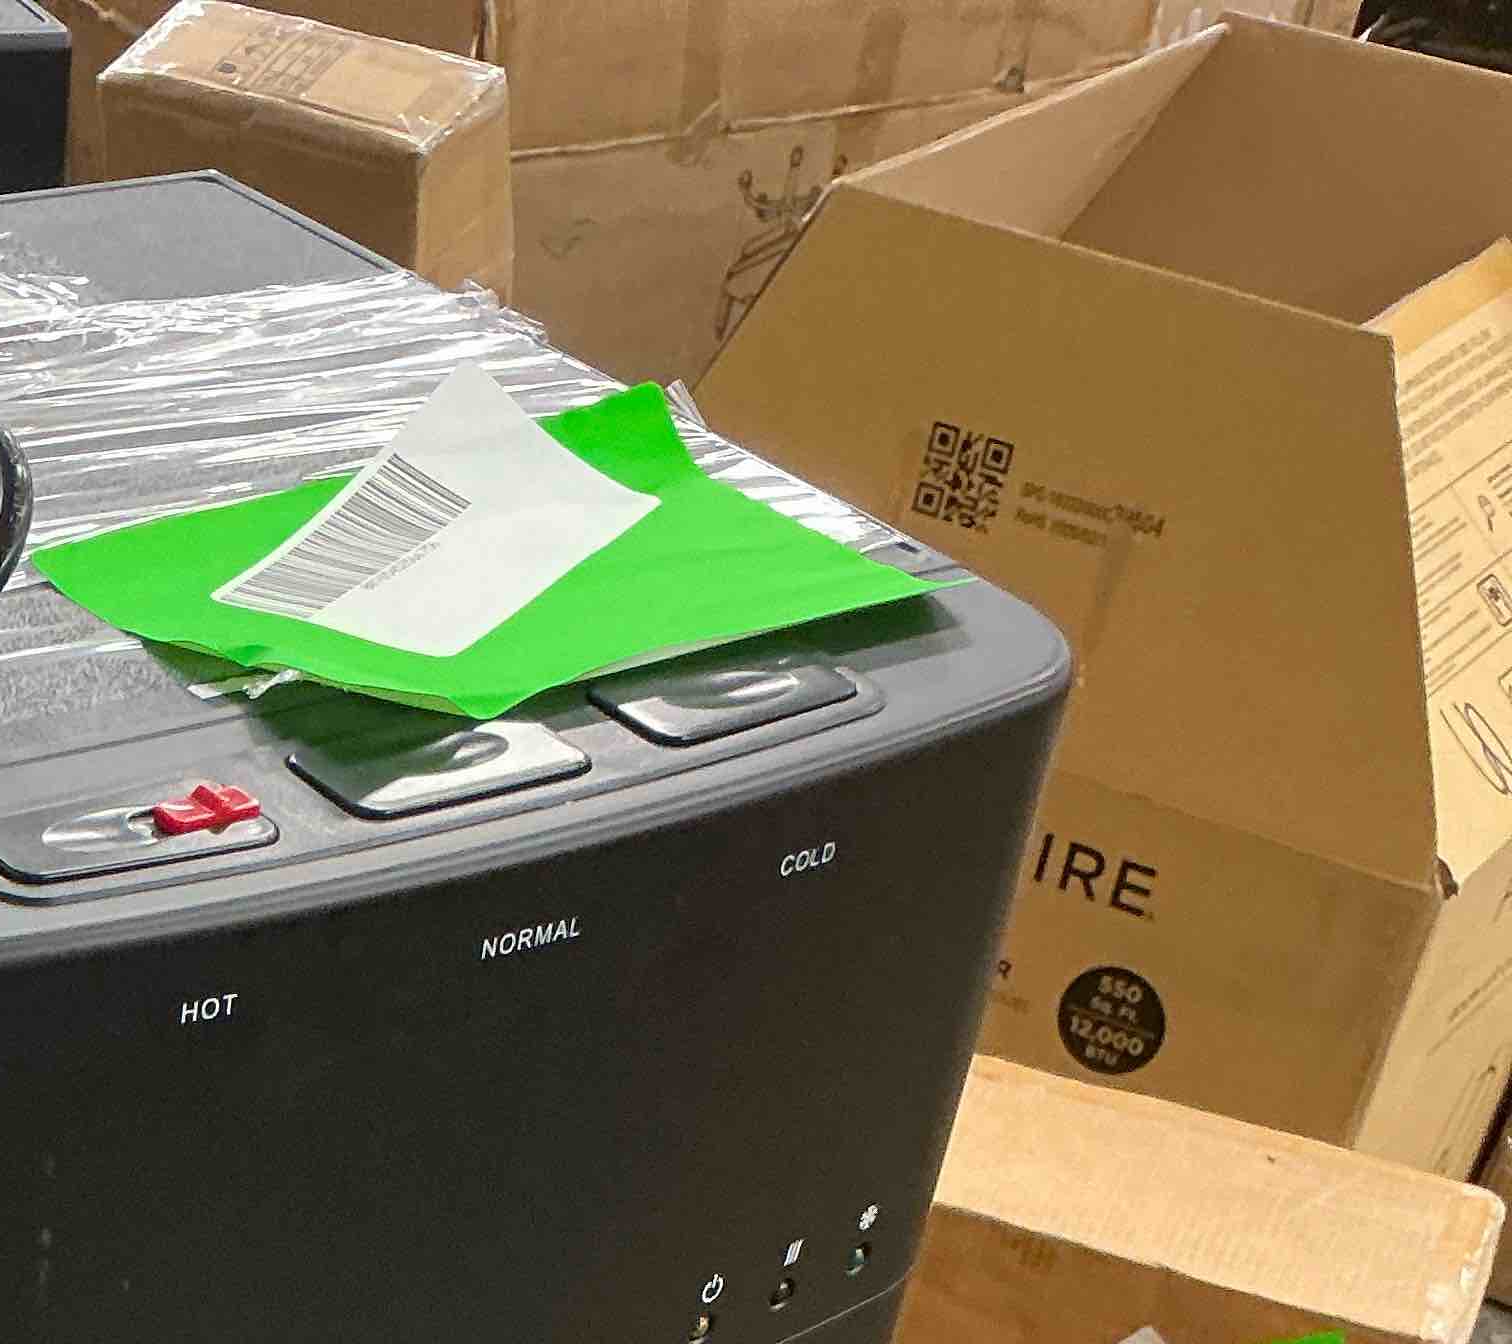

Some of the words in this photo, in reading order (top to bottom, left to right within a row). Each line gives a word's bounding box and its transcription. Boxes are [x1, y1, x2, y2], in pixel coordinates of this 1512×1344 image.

[780, 841, 836, 877] COLD
[481, 917, 580, 961] NORMAL
[180, 993, 239, 1025] HOT
